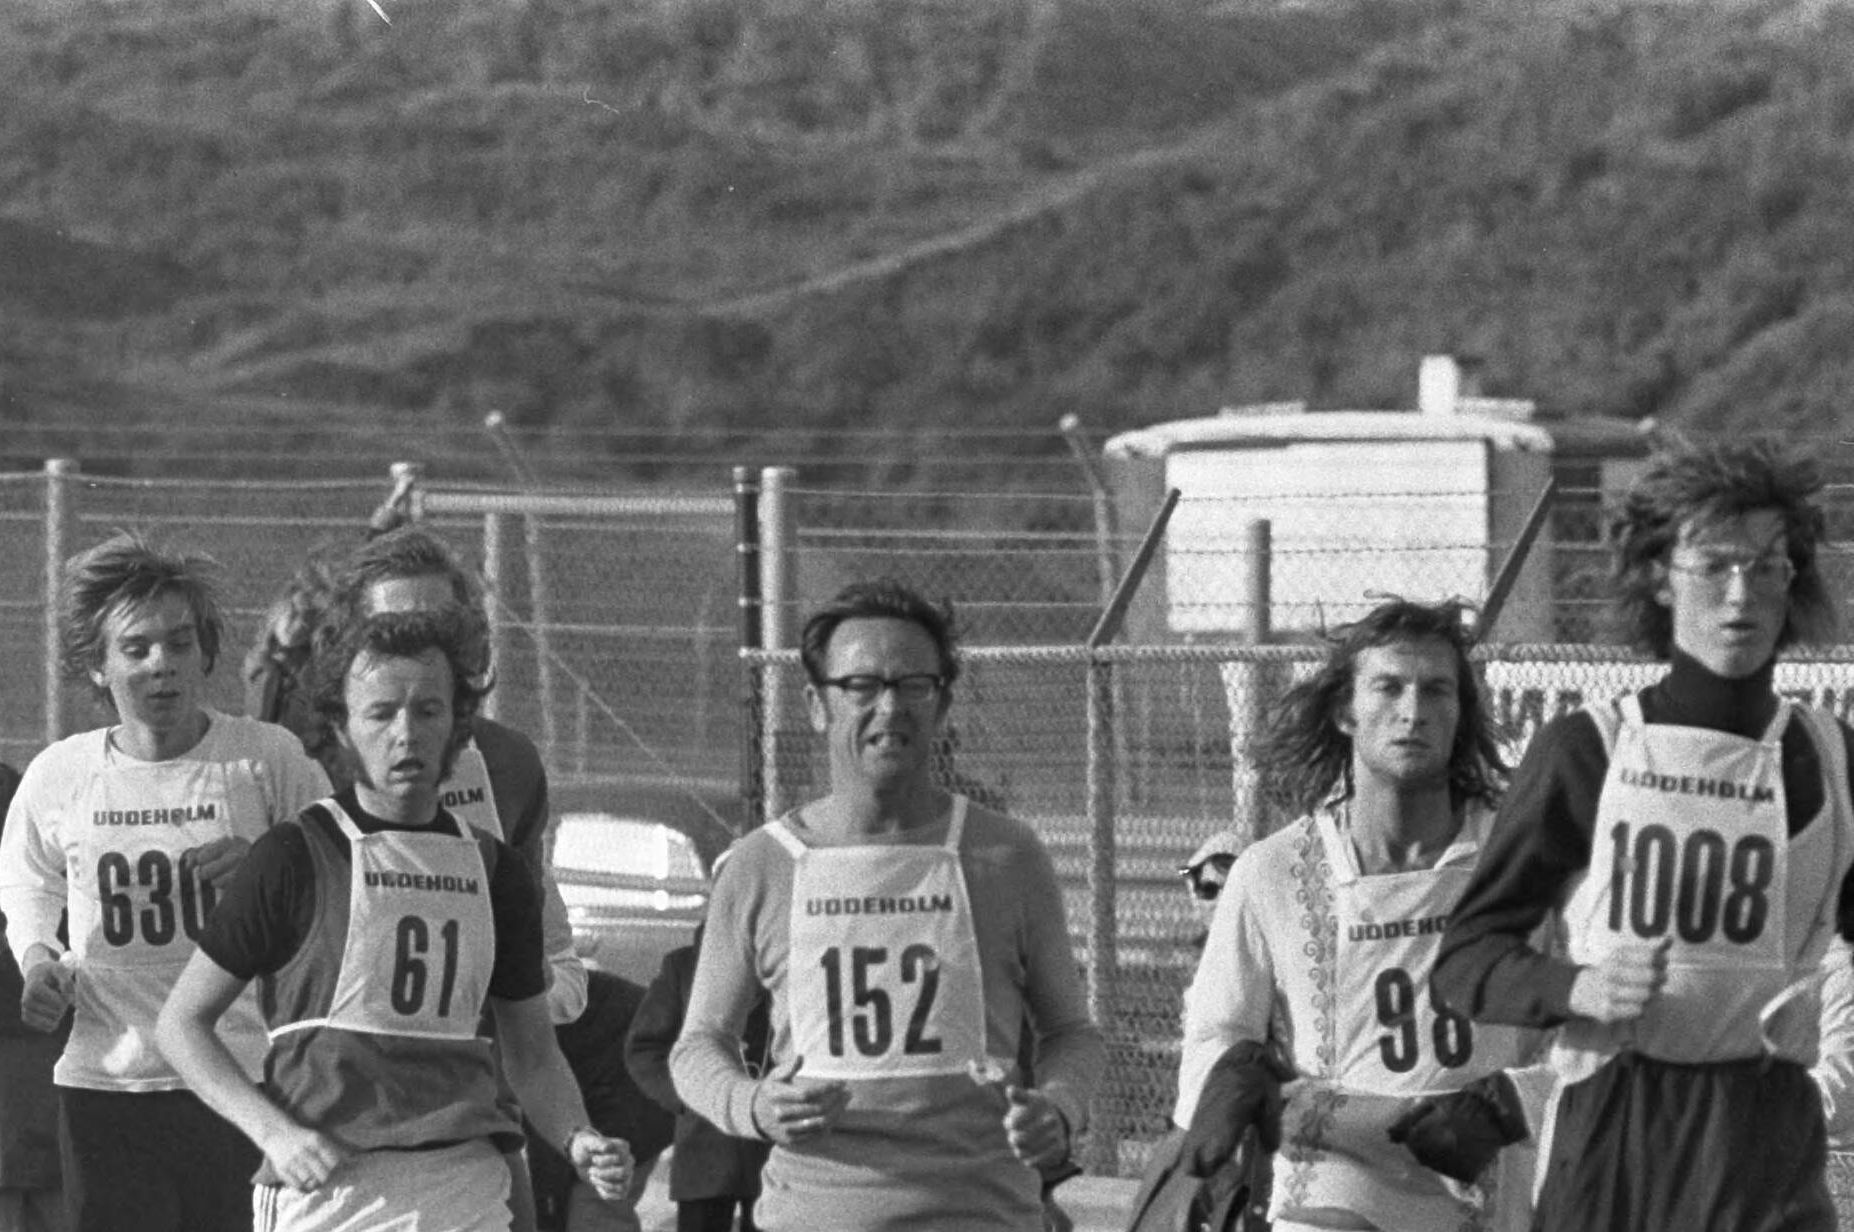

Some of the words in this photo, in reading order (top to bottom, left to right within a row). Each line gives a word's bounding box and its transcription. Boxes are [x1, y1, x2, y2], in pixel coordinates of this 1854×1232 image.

[1621, 768, 1775, 803] UDDEHOLM
[92, 803, 216, 826] UDDEHOLM
[97, 849, 218, 947] 630
[365, 870, 480, 895] UDDEHOLM
[1608, 819, 1775, 945] 1008
[806, 894, 953, 916] UDDEHOLM
[1348, 915, 1447, 943] UDDEHO
[391, 914, 459, 1018] 61
[820, 943, 943, 1057] 152
